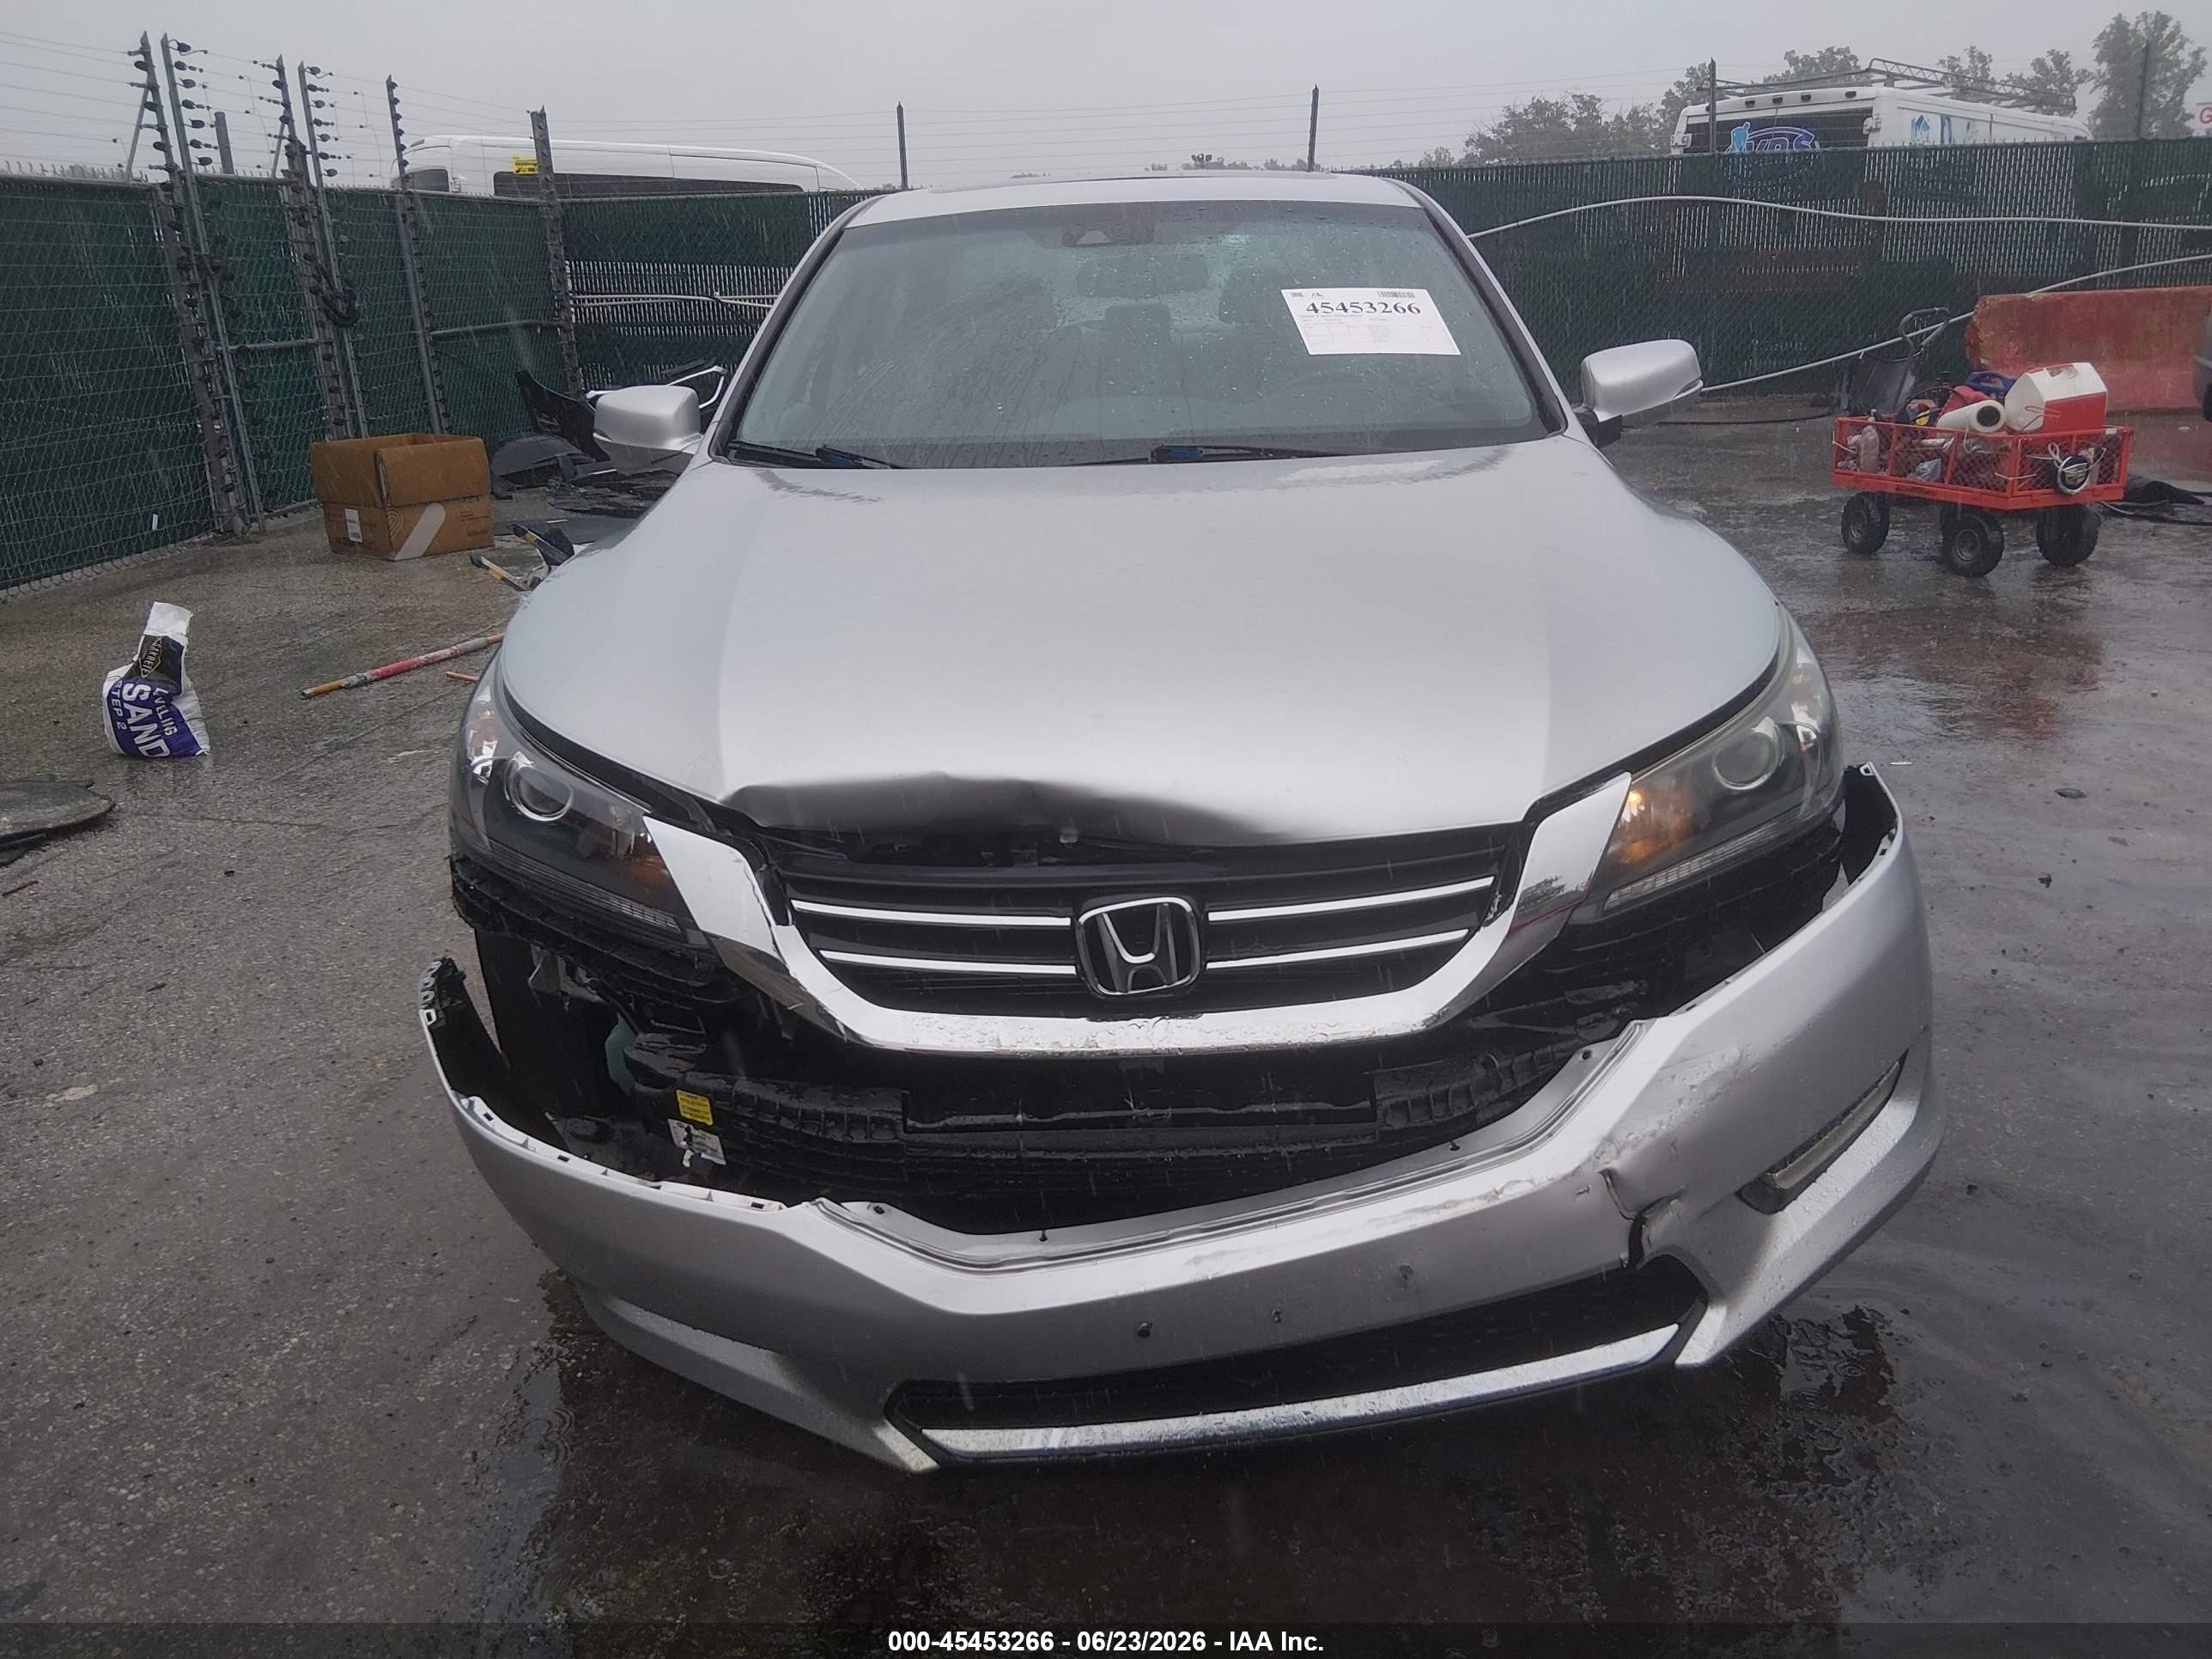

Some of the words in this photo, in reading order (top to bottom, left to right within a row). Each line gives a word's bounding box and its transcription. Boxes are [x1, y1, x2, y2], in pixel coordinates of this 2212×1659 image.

[1306, 301, 1421, 315] 45453266
[118, 720, 126, 730] 2
[122, 684, 171, 757] SAND
